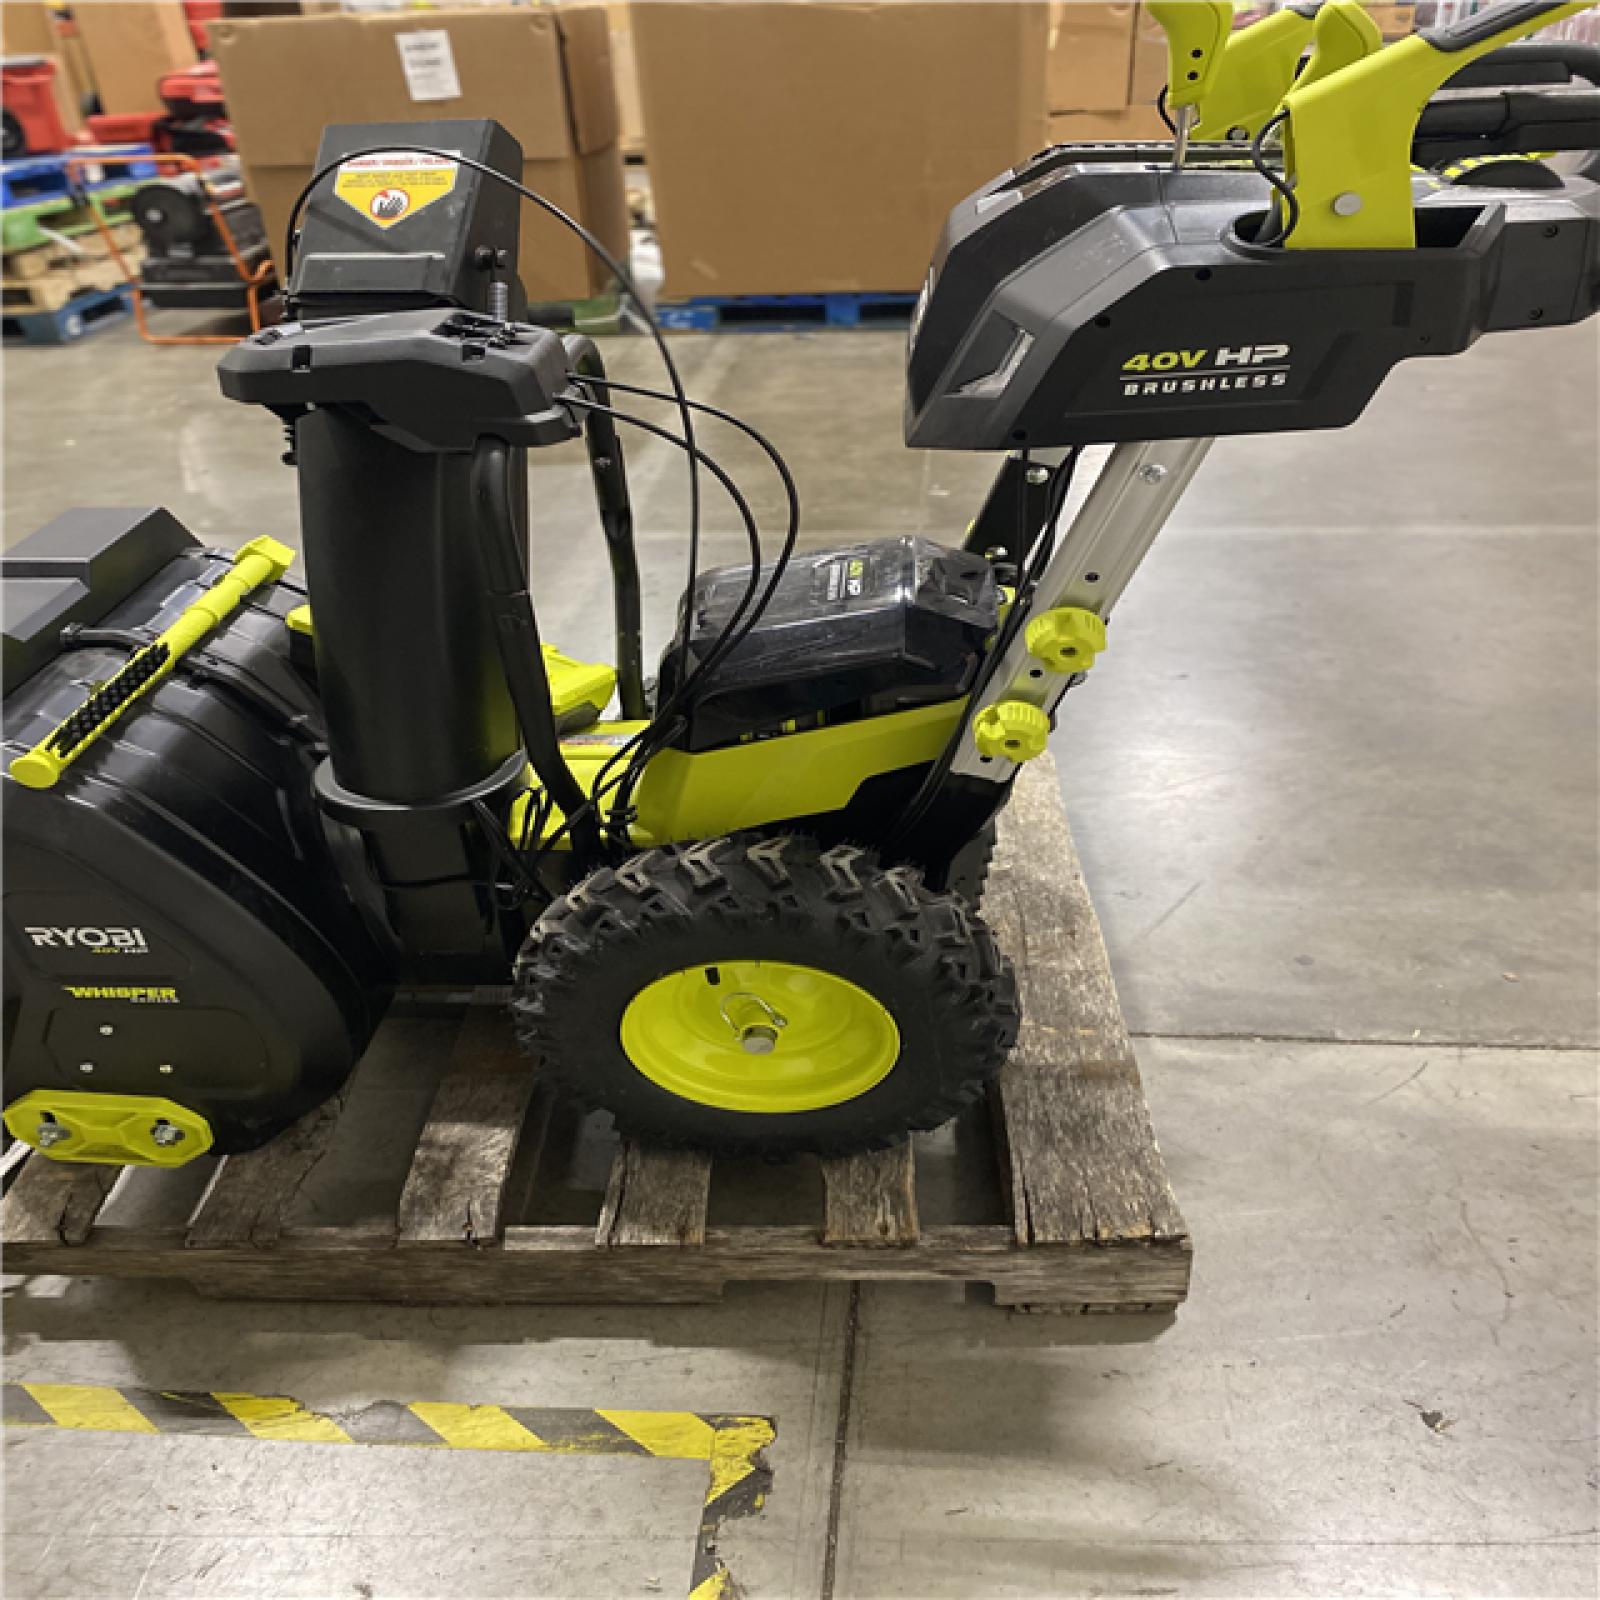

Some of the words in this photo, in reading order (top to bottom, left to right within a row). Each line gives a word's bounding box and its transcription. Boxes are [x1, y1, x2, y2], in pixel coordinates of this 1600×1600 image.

[1122, 350, 1208, 371] 40V
[1215, 344, 1290, 366] HP
[1124, 372, 1286, 396] BRUSHLESS
[25, 927, 147, 946] RYOBI
